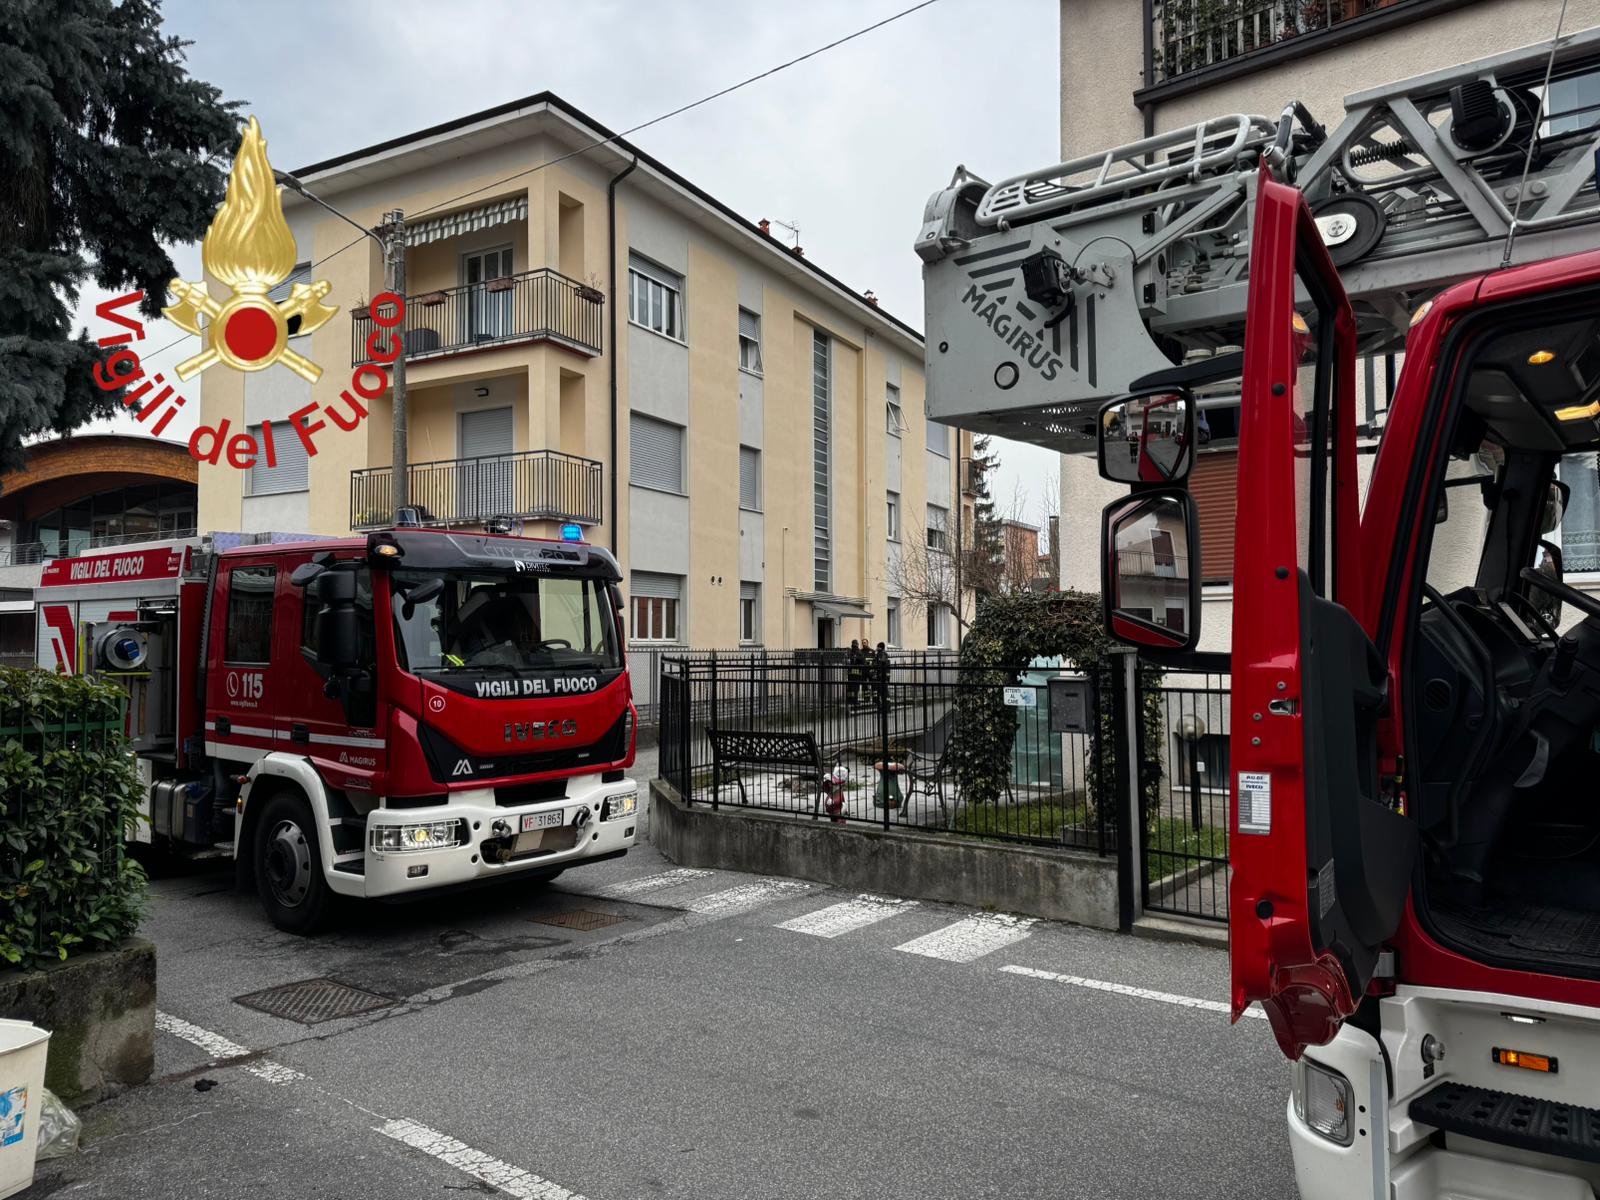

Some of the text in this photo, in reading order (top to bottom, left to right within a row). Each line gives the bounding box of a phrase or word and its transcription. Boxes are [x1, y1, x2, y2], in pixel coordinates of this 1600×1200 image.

[961, 284, 1063, 381] MAGIRUS
[70, 560, 93, 580] VIGILI
[93, 559, 111, 578] DEL
[112, 556, 145, 577] FUOCO
[242, 672, 263, 699] 115
[475, 676, 597, 698] VIGILI DEL FUOCO
[433, 700, 442, 708] 10
[504, 719, 577, 743] IVECO
[349, 756, 376, 767] MAGIRUS
[524, 812, 561, 830] VF 31863
